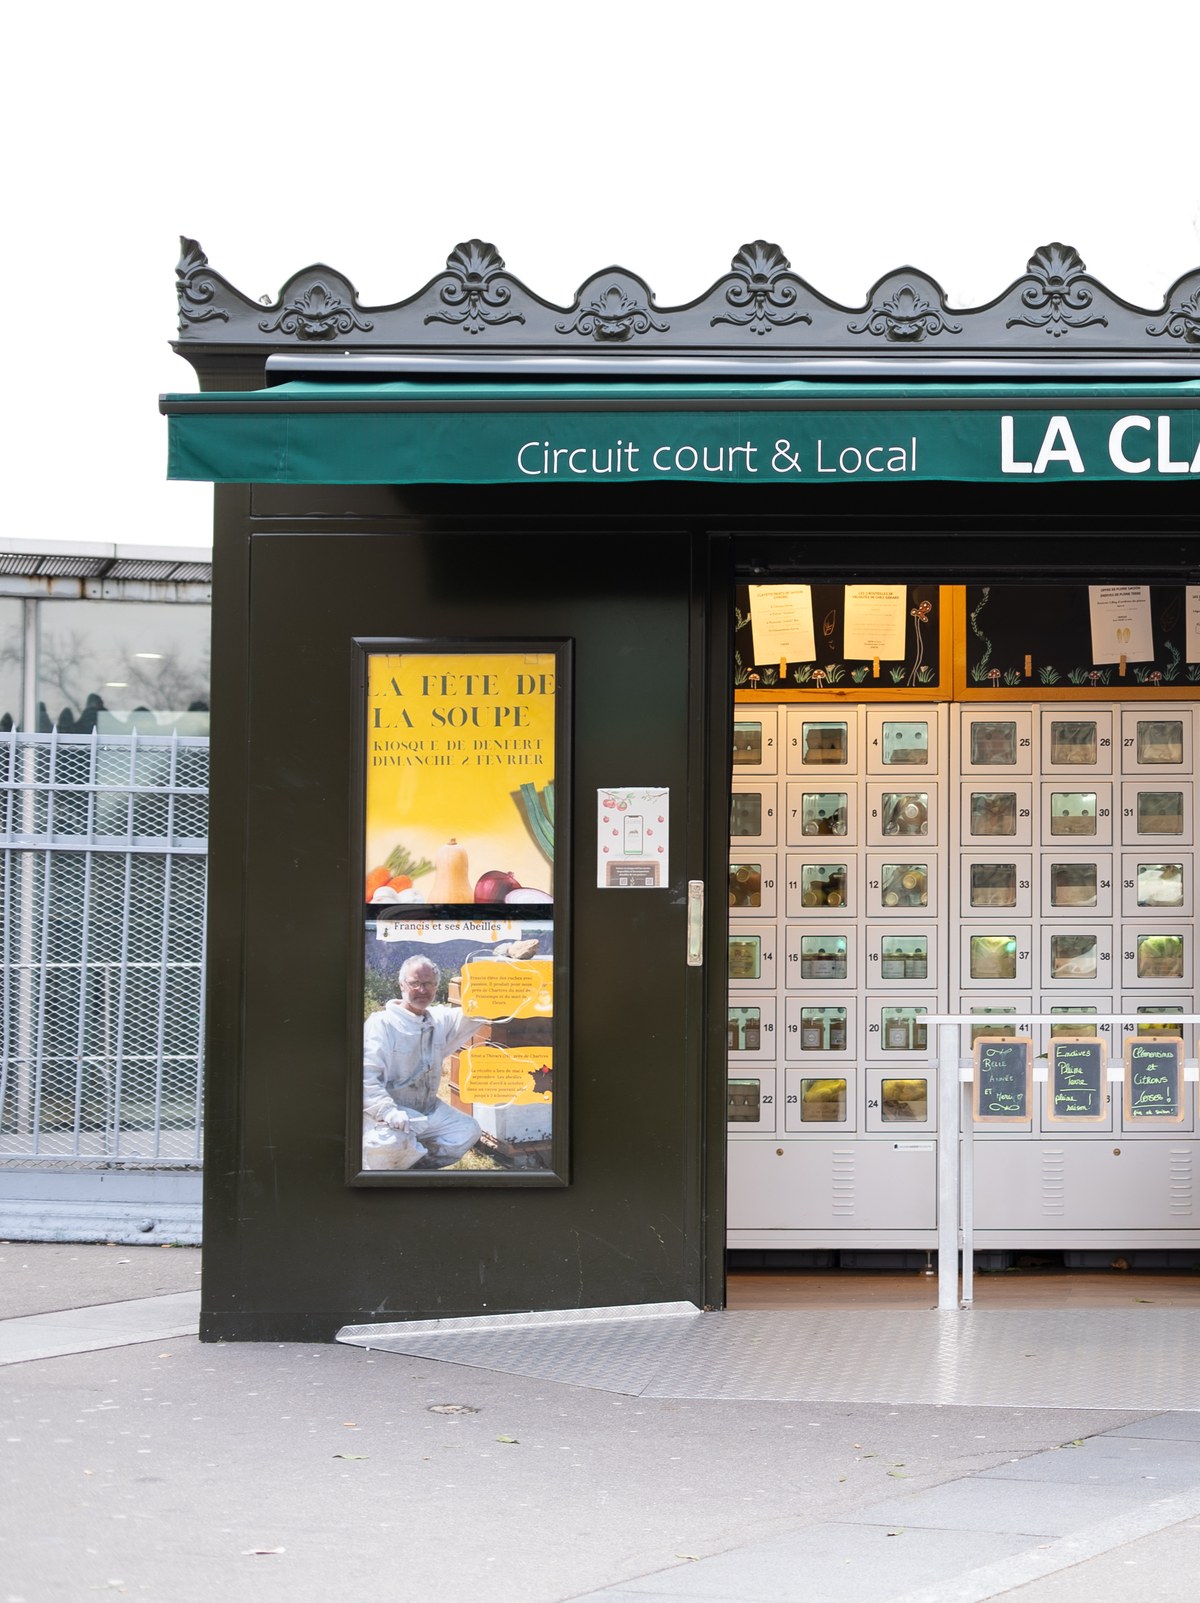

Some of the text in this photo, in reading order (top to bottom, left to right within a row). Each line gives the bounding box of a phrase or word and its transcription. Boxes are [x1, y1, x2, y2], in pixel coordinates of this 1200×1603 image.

[1000, 415, 1085, 474] LA
[517, 437, 917, 475] Circuit court & Local
[421, 672, 499, 696] FÊTE
[517, 674, 556, 695] DE
[373, 706, 530, 728] LA SOUPE
[374, 739, 544, 751] KIOSQUE DE DENFERT
[767, 738, 773, 746] 2
[791, 738, 797, 746] 3
[872, 738, 878, 747] 4
[1019, 738, 1030, 747] 25
[1100, 738, 1110, 747] 26
[1124, 738, 1134, 747] 27
[373, 755, 455, 767] DIMANCHE
[767, 808, 773, 817] 6
[791, 809, 797, 818] 7
[872, 809, 878, 818] 8
[1019, 809, 1030, 817] 29
[1099, 809, 1109, 817] 30
[1123, 809, 1134, 817] 31
[764, 880, 774, 888] 10
[788, 881, 798, 889] 11
[868, 881, 879, 889] 12
[1019, 880, 1030, 889] 33
[1100, 880, 1110, 888] 34
[1124, 880, 1134, 888] 35
[394, 922, 429, 931] Francis
[464, 922, 501, 931] Abeilles
[763, 952, 773, 961] 14
[788, 954, 798, 962] 15
[868, 953, 879, 962] 16
[1019, 952, 1029, 960] 37
[1100, 953, 1110, 961] 38
[1124, 952, 1135, 960] 39
[763, 1024, 774, 1032] 18
[787, 1024, 798, 1033] 19
[869, 1024, 879, 1032] 20
[1018, 1024, 1029, 1032] 41
[1099, 1024, 1110, 1032] 42
[1124, 1024, 1134, 1032] 43
[762, 1095, 773, 1104] 22
[787, 1096, 797, 1104] 23
[868, 1100, 878, 1108] 24
